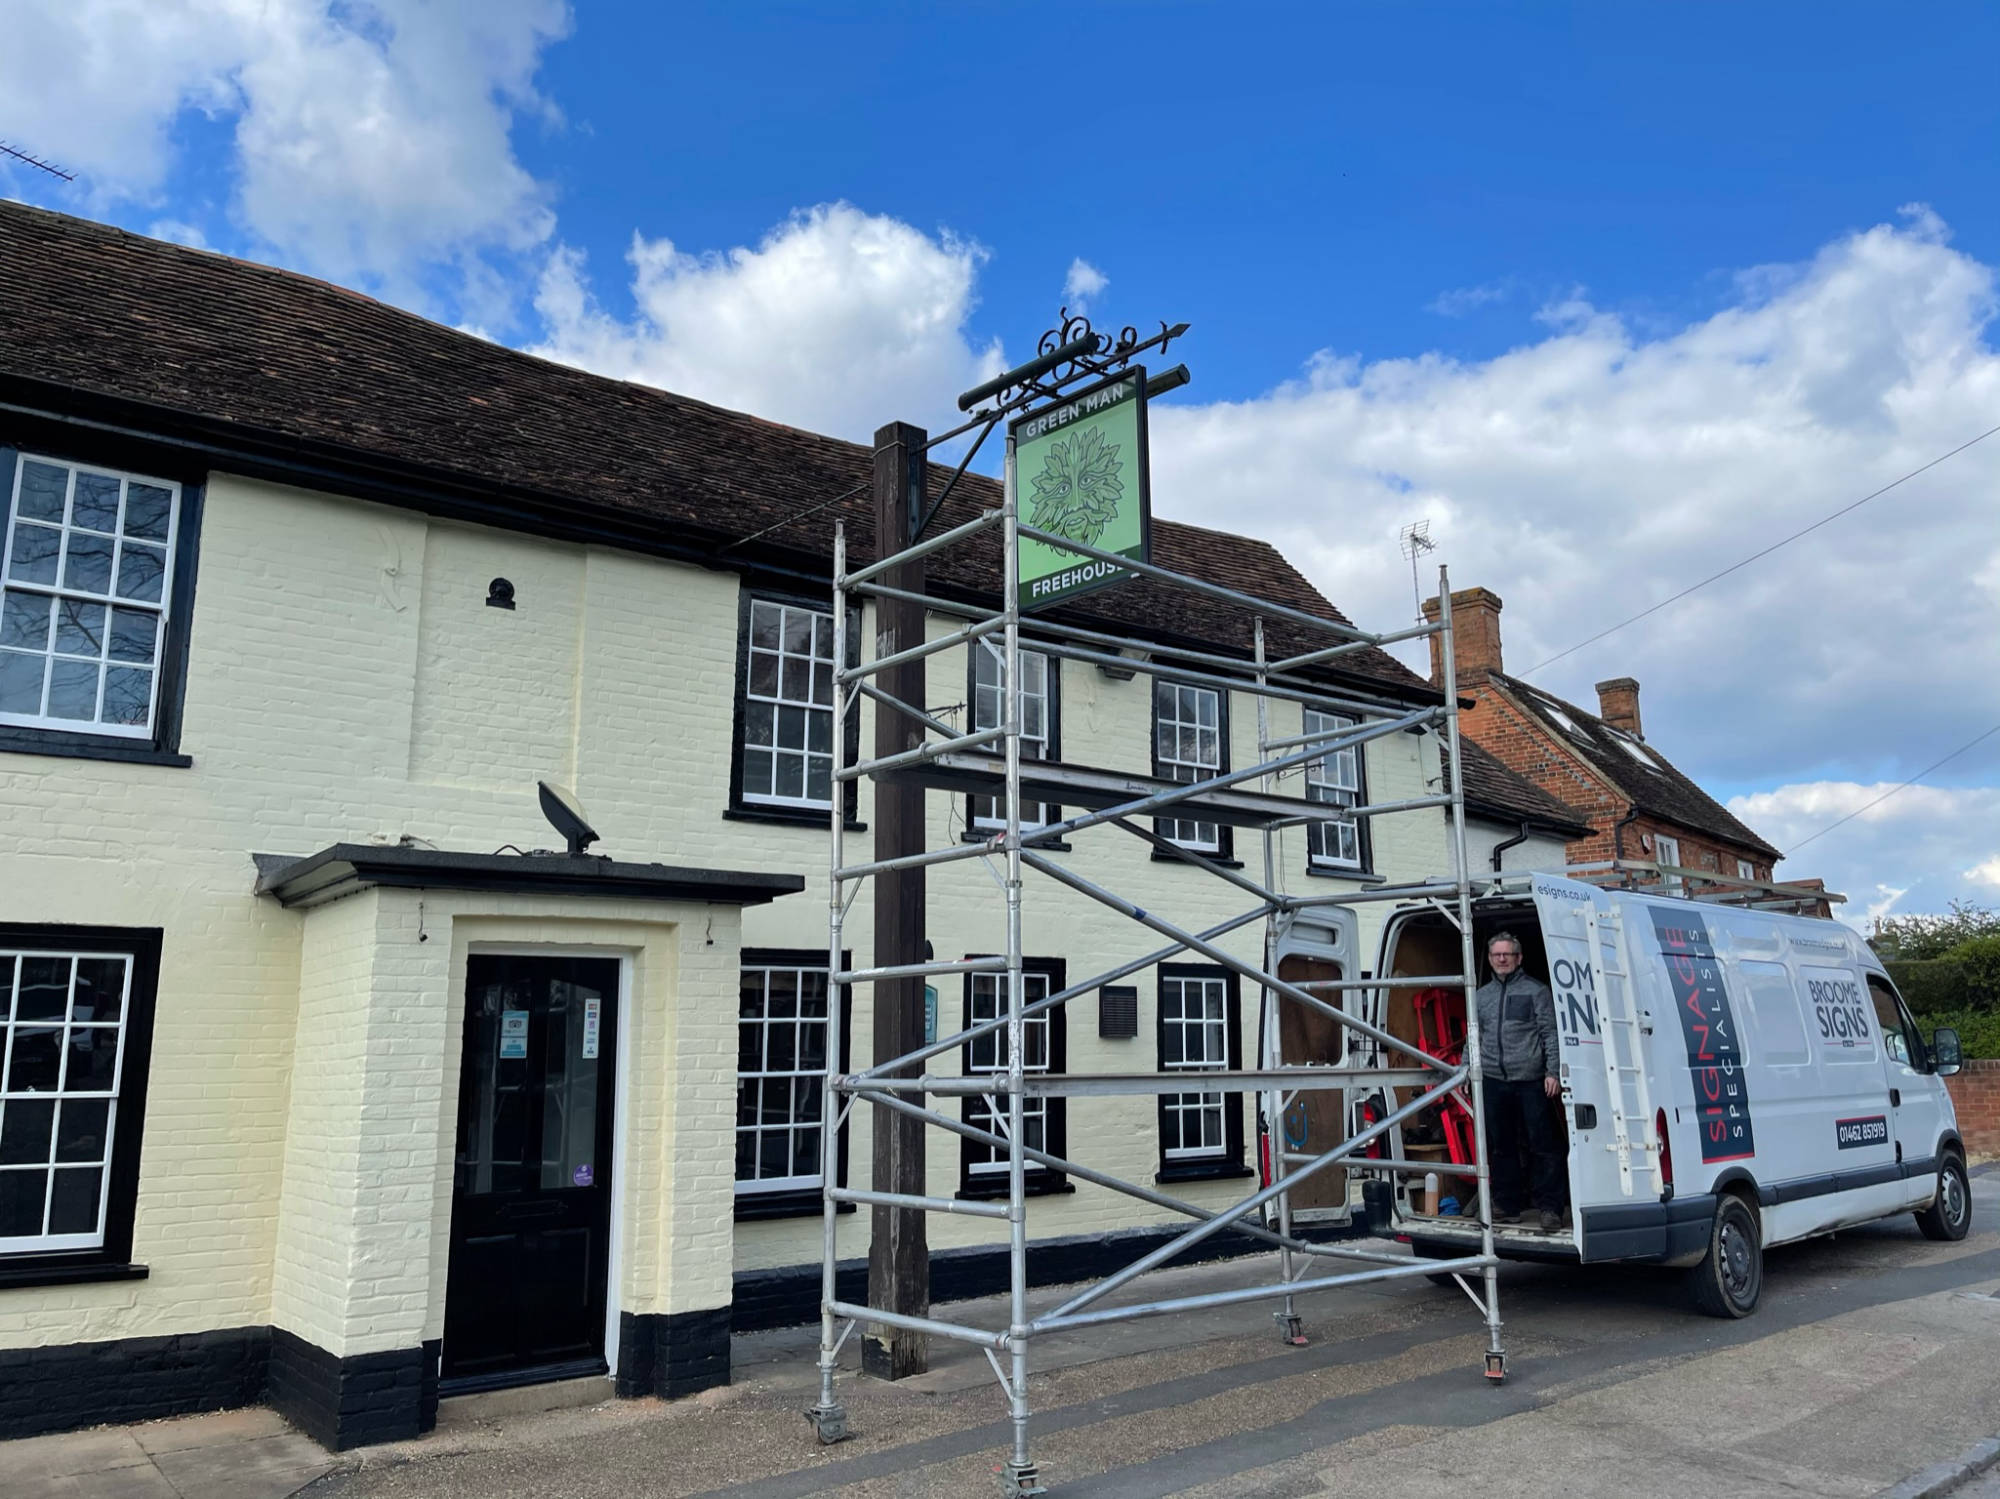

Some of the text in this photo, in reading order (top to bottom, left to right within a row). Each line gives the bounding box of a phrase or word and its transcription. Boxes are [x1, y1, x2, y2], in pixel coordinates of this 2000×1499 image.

[1026, 384, 1124, 437] GREEN MAN
[1032, 554, 1126, 598] FREEHOUS
[1808, 980, 1861, 1004] BROOME
[1665, 927, 1727, 1142] SIGNAGE
[1689, 929, 1744, 1139] SPECIALISTS
[1816, 1006, 1869, 1038] SIGNS
[1840, 1122, 1885, 1143] 01462 851919
